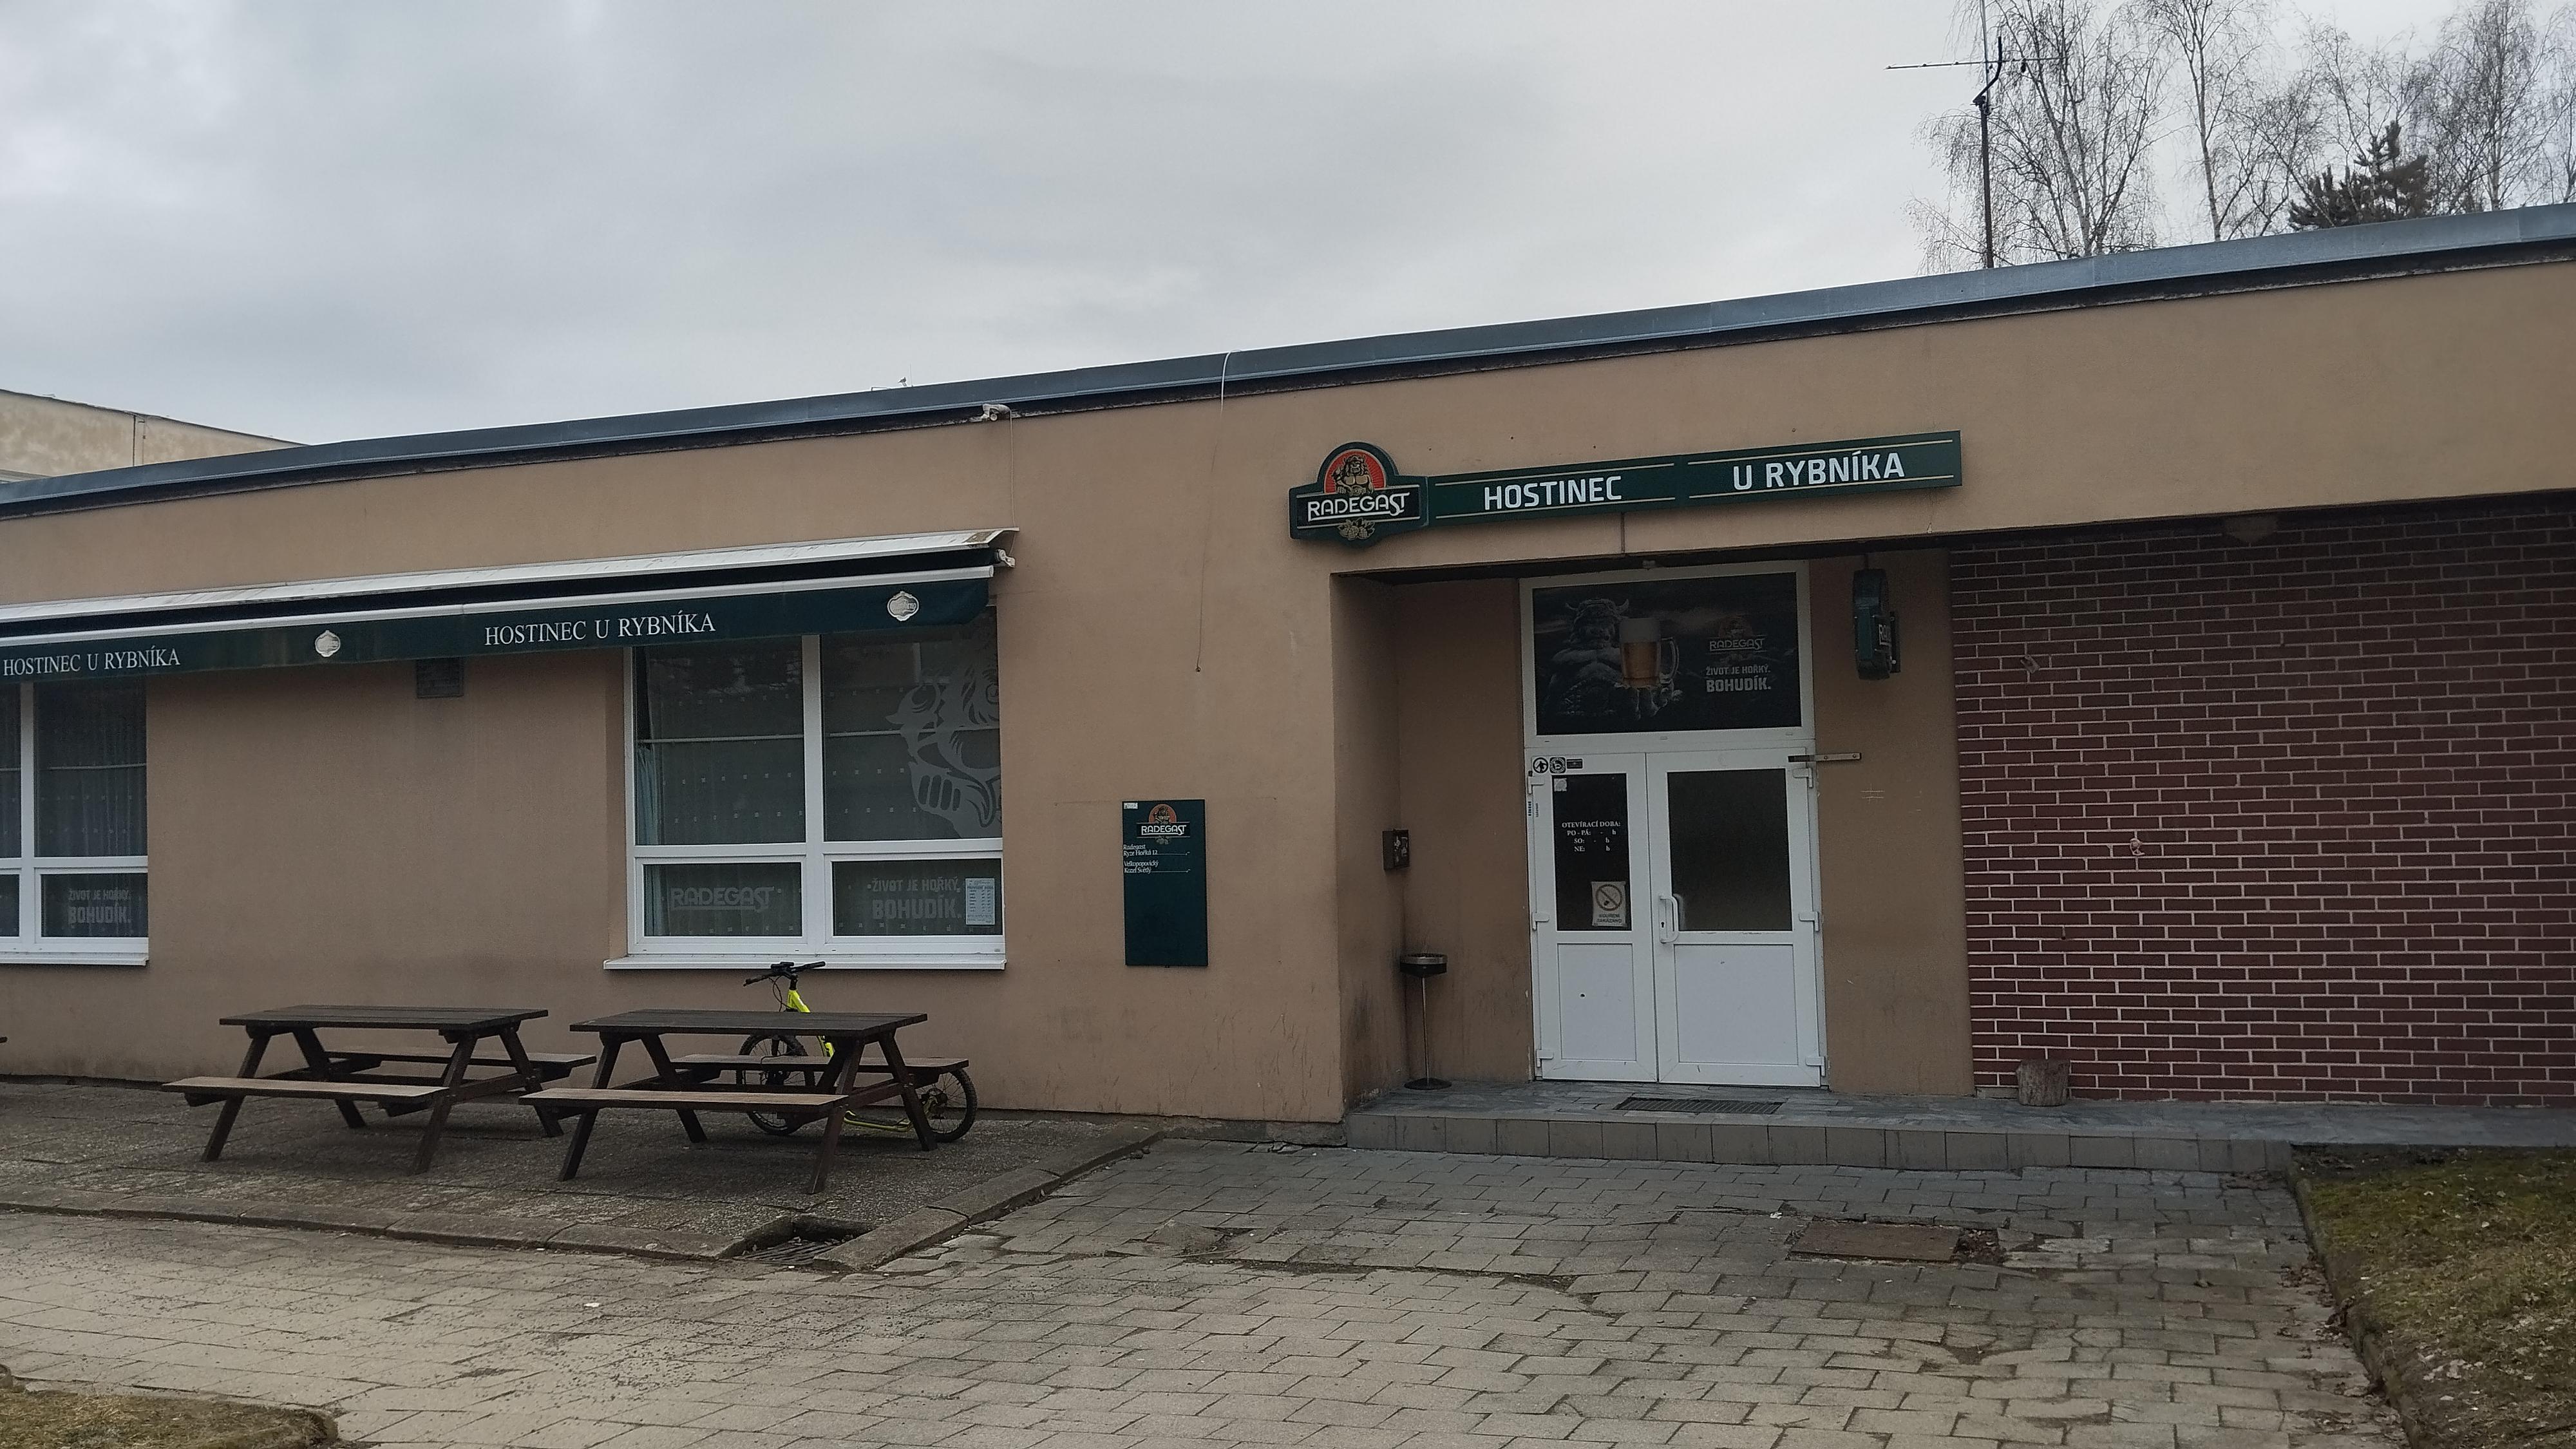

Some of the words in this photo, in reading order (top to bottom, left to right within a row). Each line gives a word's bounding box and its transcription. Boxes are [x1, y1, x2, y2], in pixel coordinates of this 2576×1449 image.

[1484, 475, 1622, 510] HOSTINEC
[1732, 464, 1752, 490] U
[1766, 450, 1905, 488] RYBNÍKA
[1308, 492, 1410, 522] RADEGAST
[484, 620, 587, 645] HOSTINEC
[594, 619, 611, 638] U
[618, 610, 716, 637] RYBNÍKA
[1709, 638, 1765, 651] RADEGAST
[3, 654, 81, 676] HOSTINEC
[87, 653, 99, 670] U
[104, 645, 181, 670] RYBNÍKA
[1705, 666, 1729, 676] ŽIVOT
[1741, 663, 1771, 674] HOŘKÝ.
[1706, 675, 1772, 692] BOHUDÍK.
[1141, 825, 1187, 835] RADEGAST
[93, 889, 101, 900] JE
[871, 878, 903, 892] ŽIVOT
[907, 879, 919, 891] JE
[670, 886, 774, 913] RADEGAST
[872, 895, 962, 920] BOHUDÍK.
[68, 902, 131, 923] BOHUDÍK.
